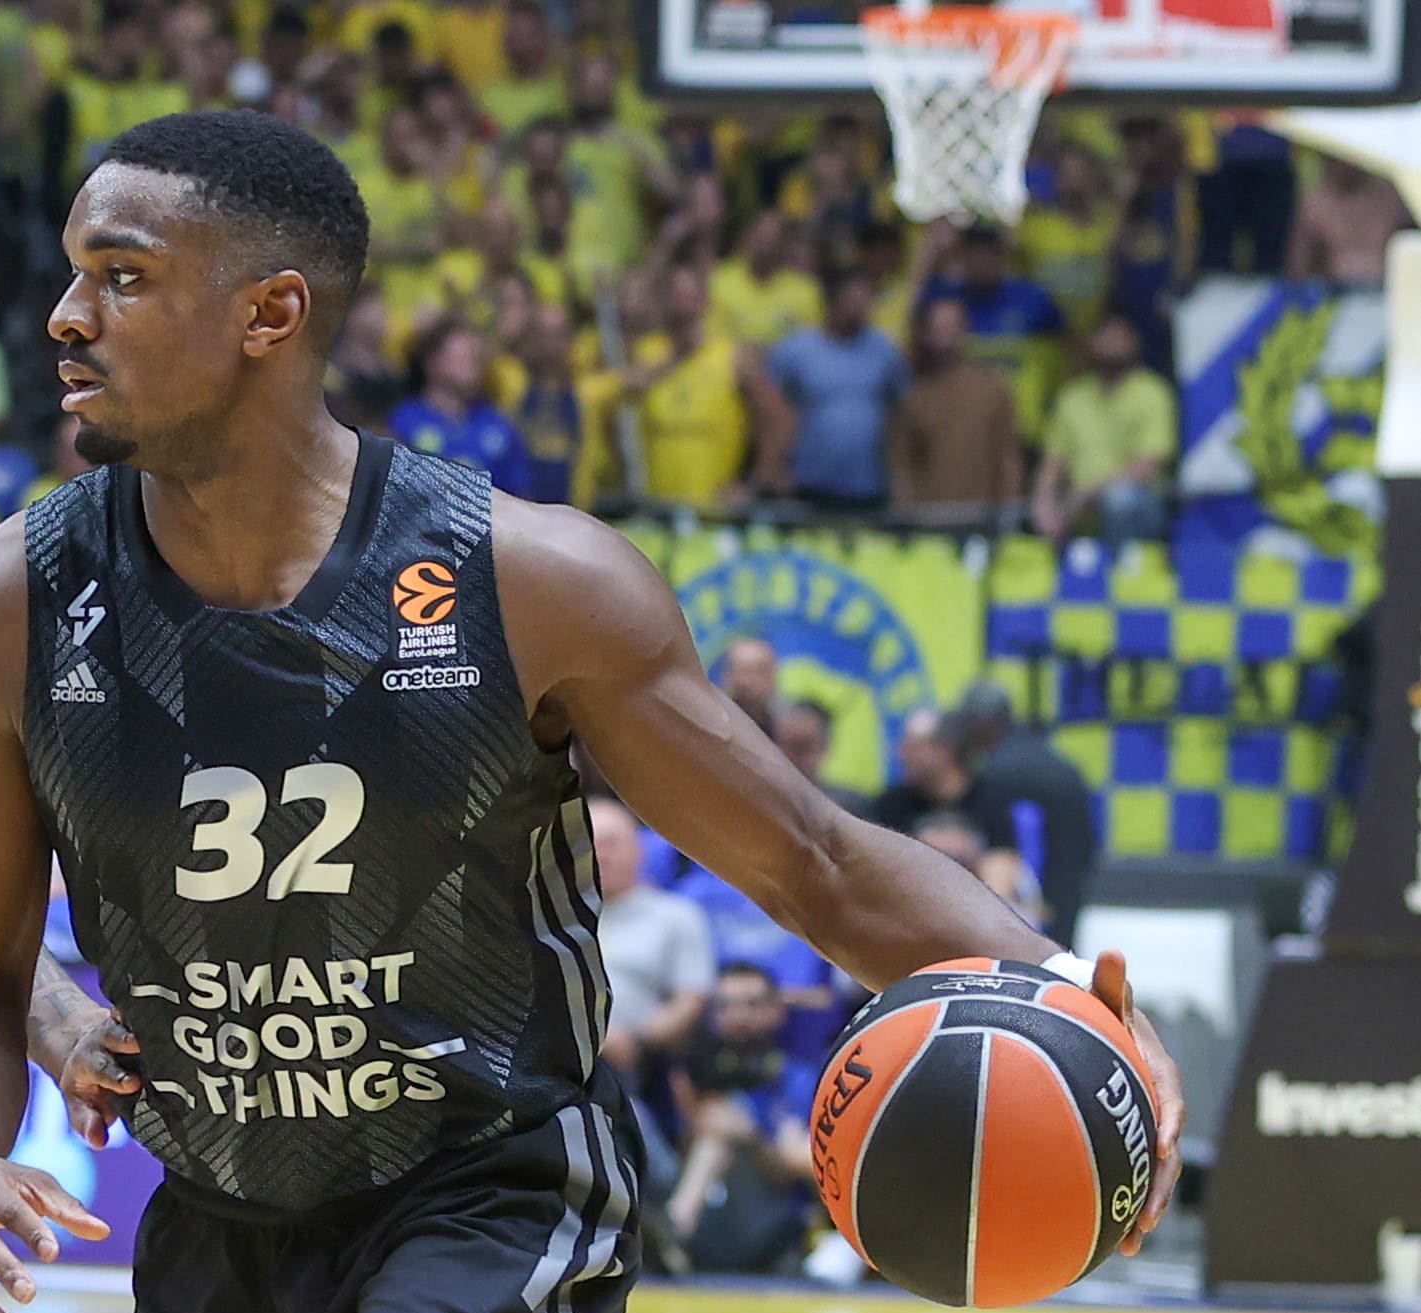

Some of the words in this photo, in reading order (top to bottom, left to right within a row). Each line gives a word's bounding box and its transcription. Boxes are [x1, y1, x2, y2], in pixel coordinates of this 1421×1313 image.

[398, 624, 456, 638] TURKISH
[399, 635, 457, 649] AIRLINES
[399, 646, 457, 659] EuroLeague
[382, 665, 480, 691] oneteam
[50, 687, 106, 703] adidas
[174, 762, 365, 902] 32
[183, 951, 416, 1014] SMART
[172, 1013, 369, 1071] GOOD
[196, 1060, 447, 1125] THINGS
